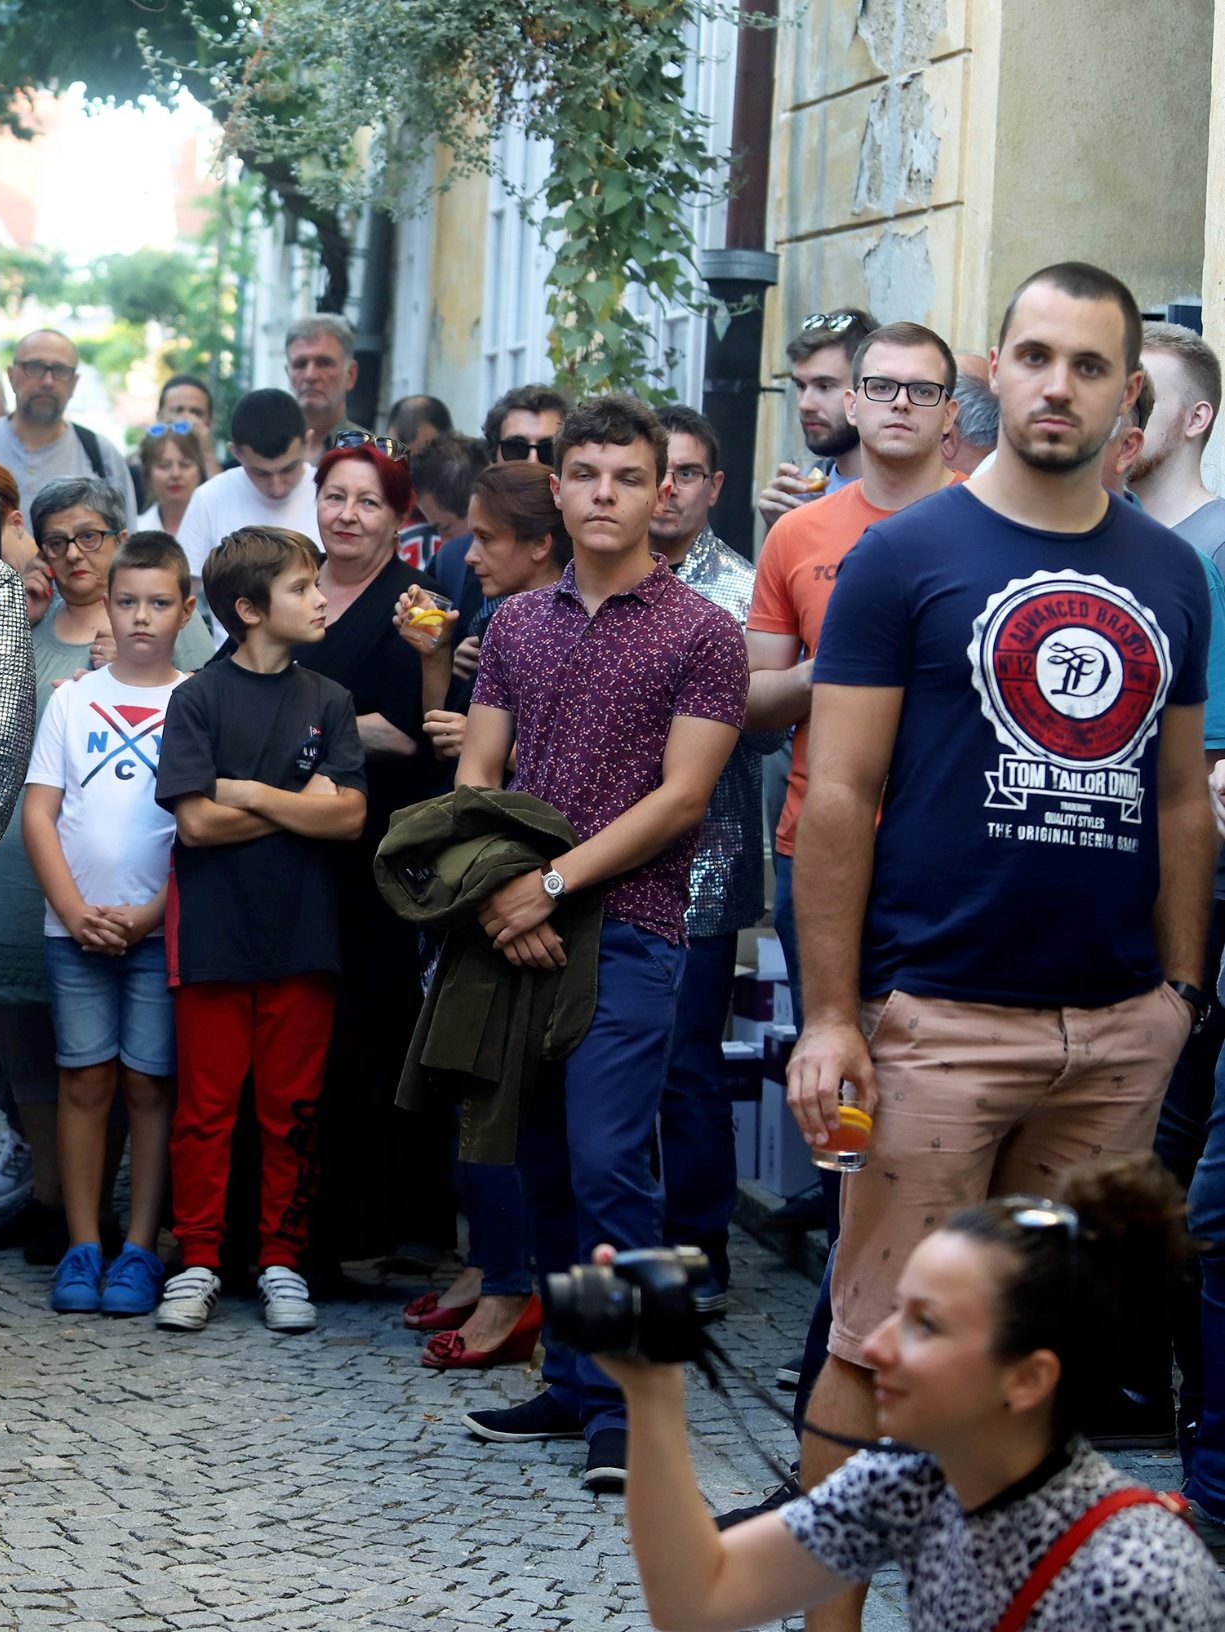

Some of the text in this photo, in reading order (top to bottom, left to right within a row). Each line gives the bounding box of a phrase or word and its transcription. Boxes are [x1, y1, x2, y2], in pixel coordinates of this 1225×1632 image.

[1009, 599, 1147, 656] ADVANCED BRAND
[1016, 655, 1033, 675] 12
[1006, 761, 1138, 799] TOM TAILOR DNM
[1044, 811, 1105, 830] QUALITY STYLES
[987, 822, 1013, 839] THE
[1017, 825, 1076, 845] ORIGINAL
